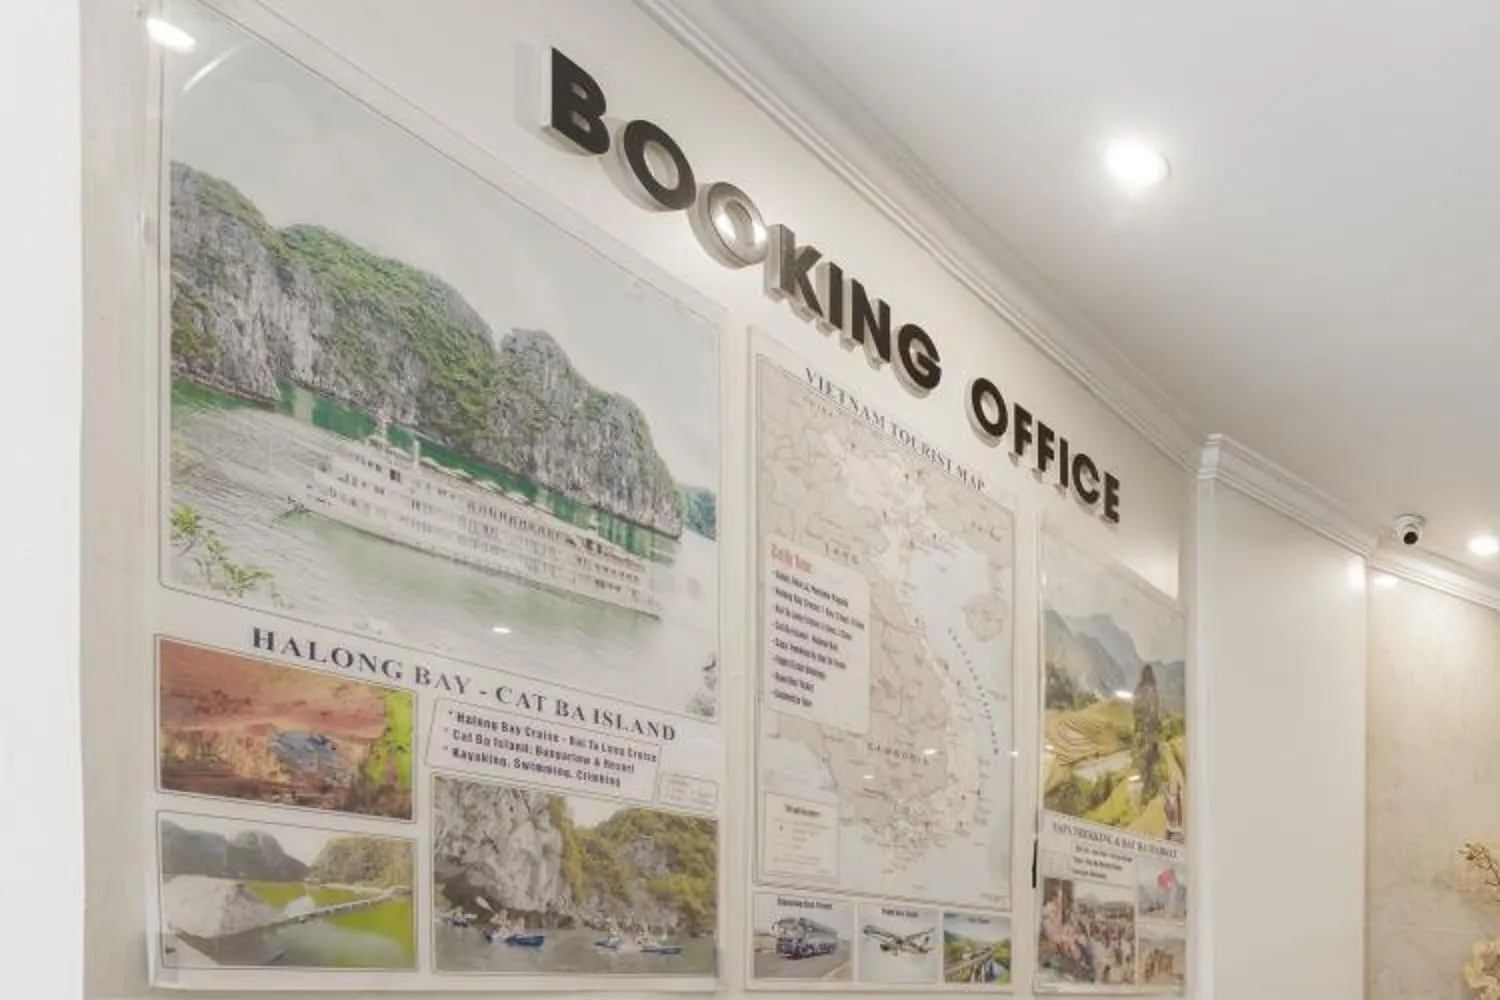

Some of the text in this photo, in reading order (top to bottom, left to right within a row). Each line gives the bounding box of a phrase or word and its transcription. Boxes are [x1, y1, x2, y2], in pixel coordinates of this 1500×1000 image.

[549, 45, 1120, 524] BOOKING OFFICE
[805, 367, 885, 429] VIETNAM
[252, 626, 403, 680] HALONG
[414, 665, 472, 698] BAY
[495, 685, 547, 713] CAT
[555, 699, 586, 721] BA
[593, 707, 677, 742] ISLAND
[453, 729, 473, 742] Cat
[457, 712, 498, 732] Halong
[501, 721, 521, 736] Bay
